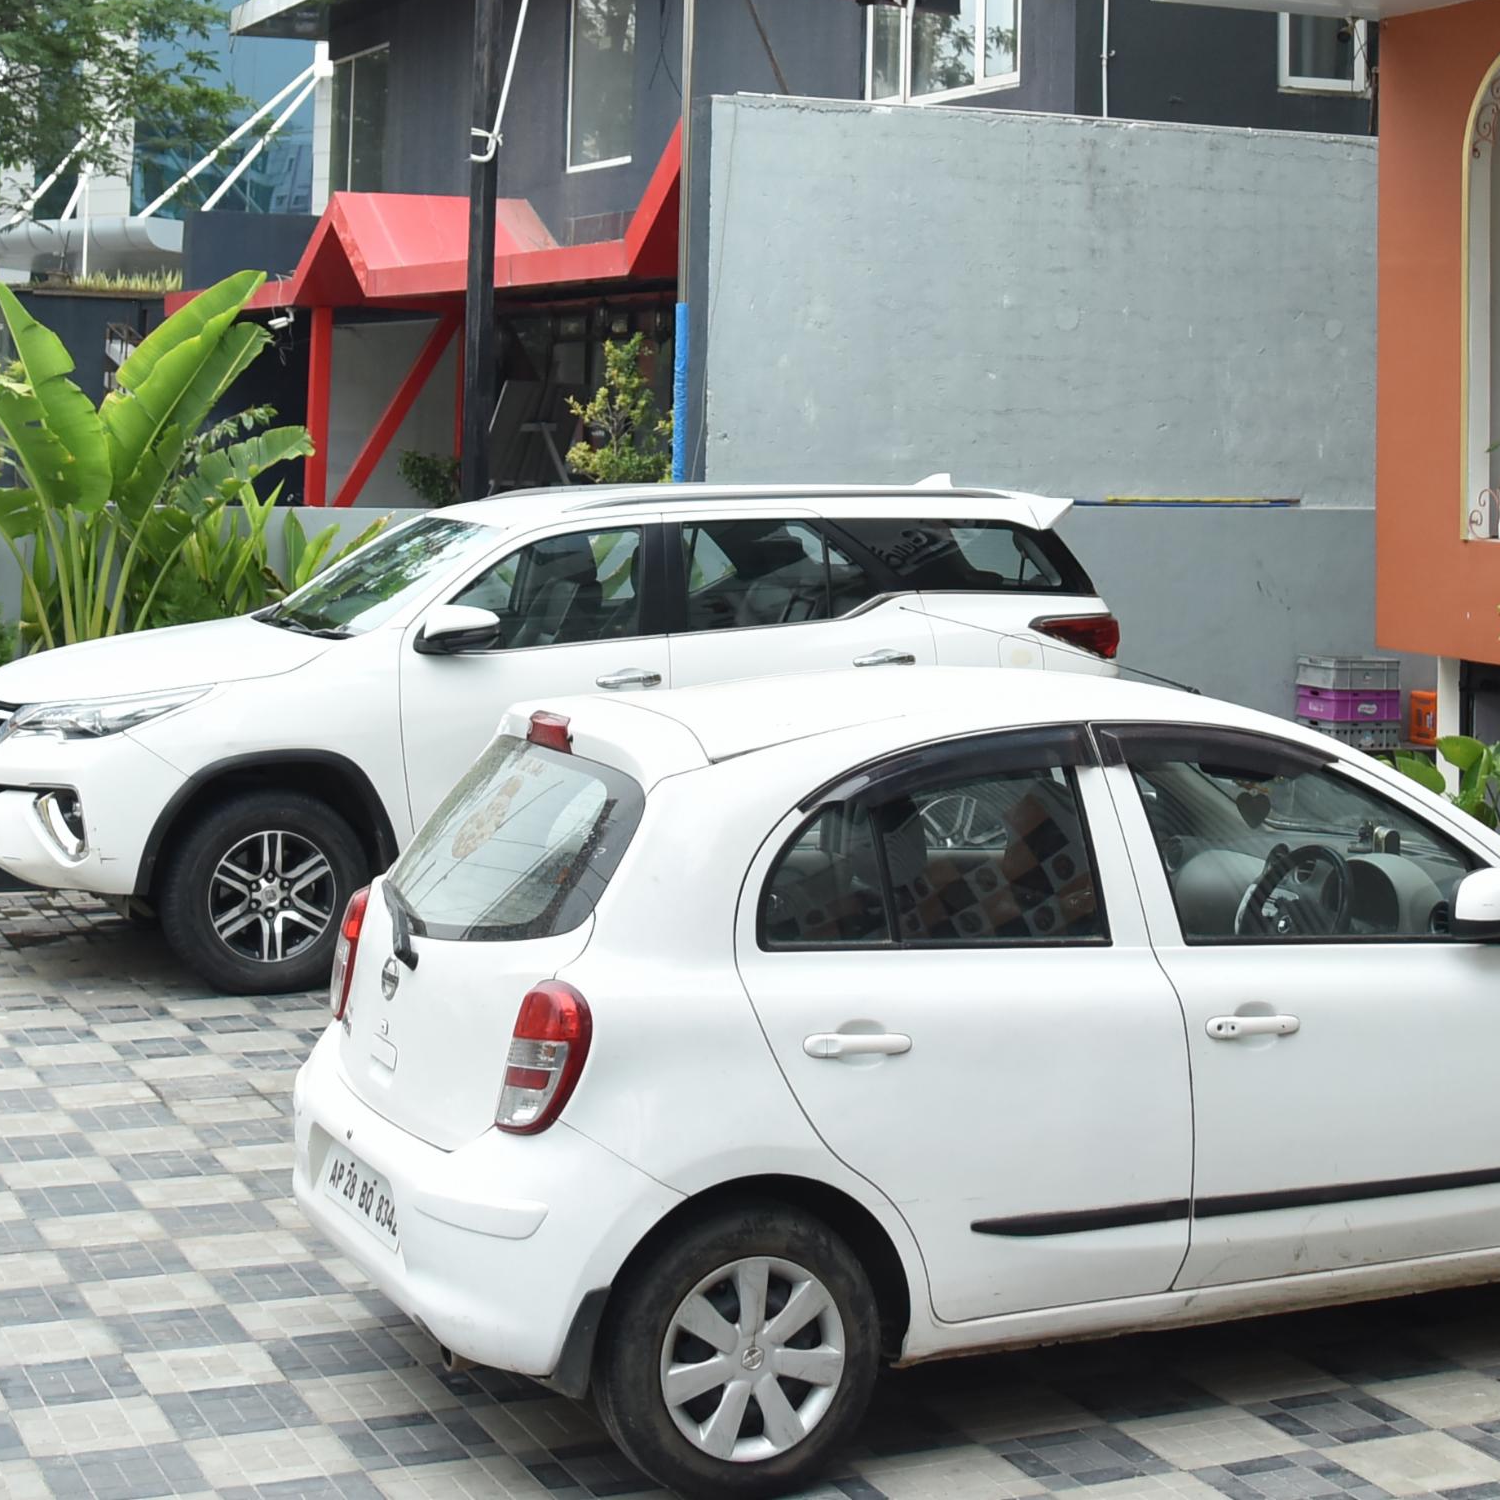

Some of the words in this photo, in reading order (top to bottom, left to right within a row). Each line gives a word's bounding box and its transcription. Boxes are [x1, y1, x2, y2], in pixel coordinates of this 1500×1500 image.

[329, 1158, 345, 1189] AP
[343, 1168, 357, 1200] 28
[358, 1180, 374, 1217] BQ
